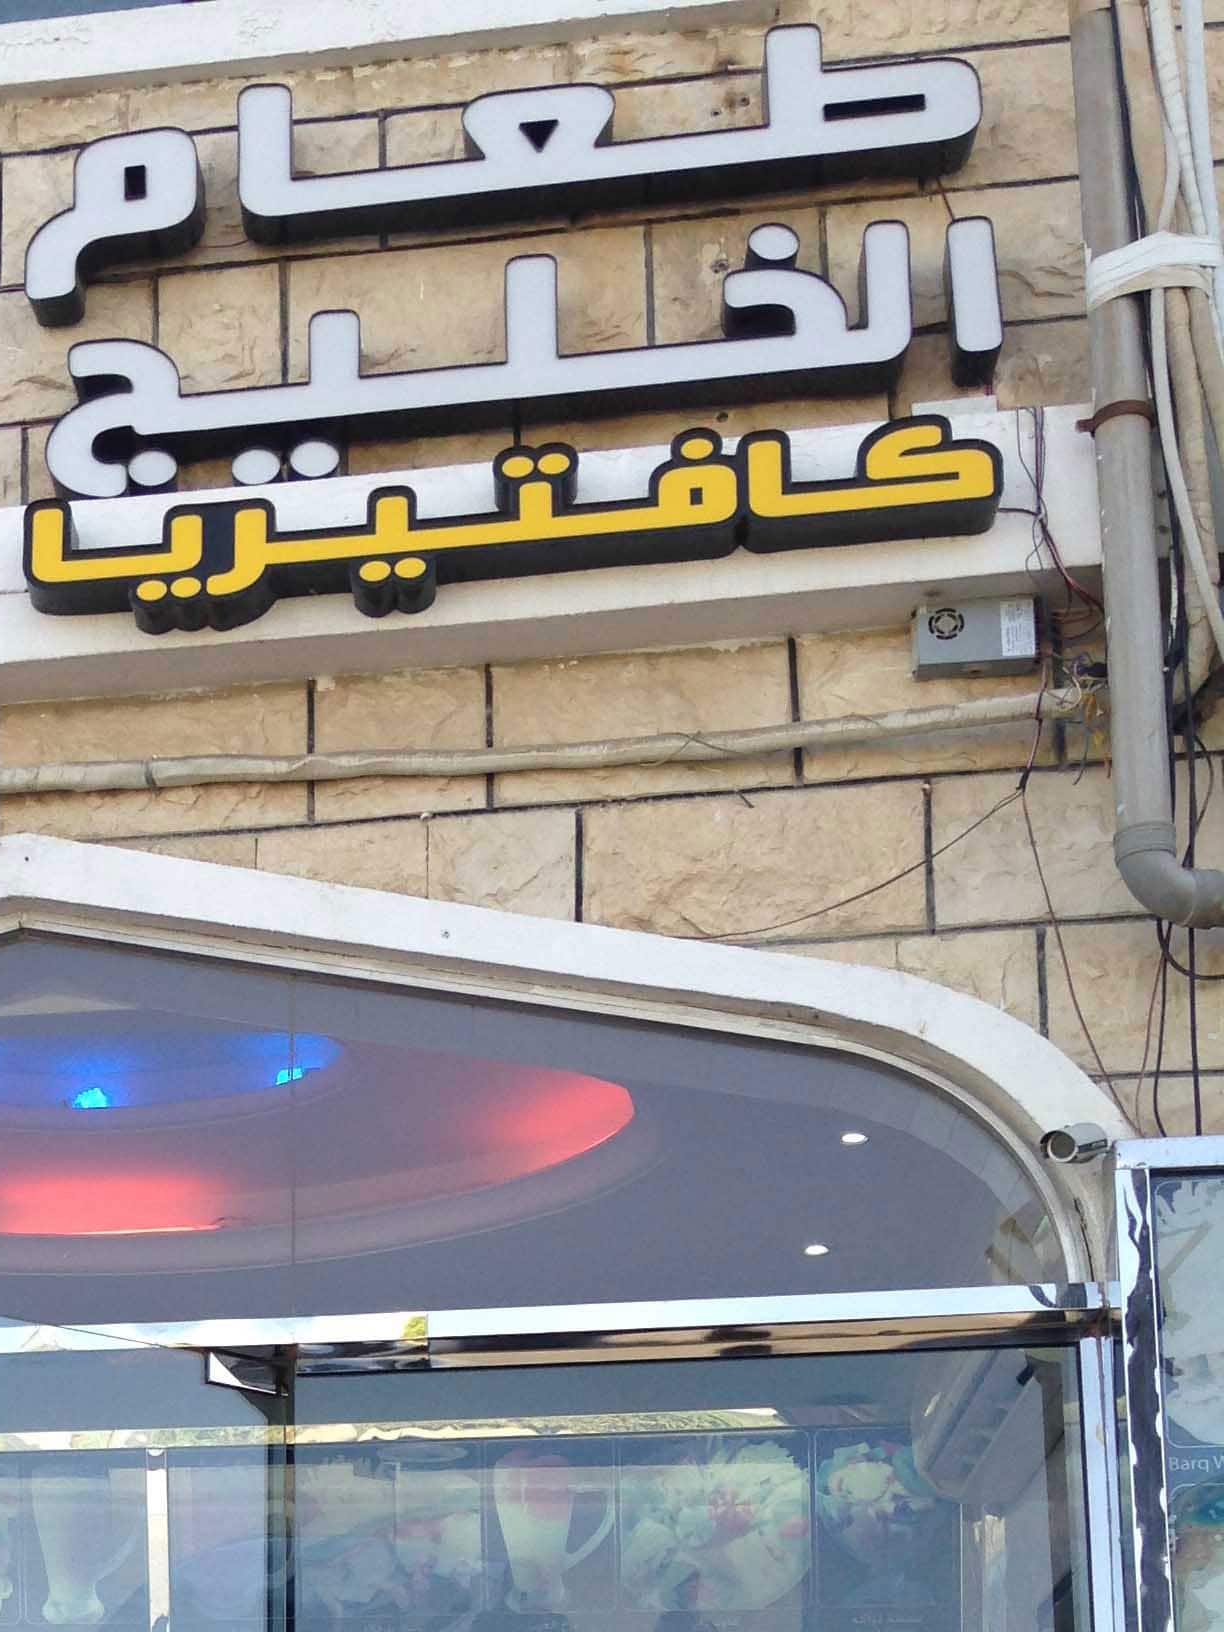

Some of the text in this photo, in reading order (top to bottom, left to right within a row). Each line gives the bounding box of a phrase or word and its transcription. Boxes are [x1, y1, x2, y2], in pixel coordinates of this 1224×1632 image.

[25, 24, 982, 324] طعام
[46, 216, 1004, 500] الخليج
[26, 417, 1001, 622] كافتيريا
